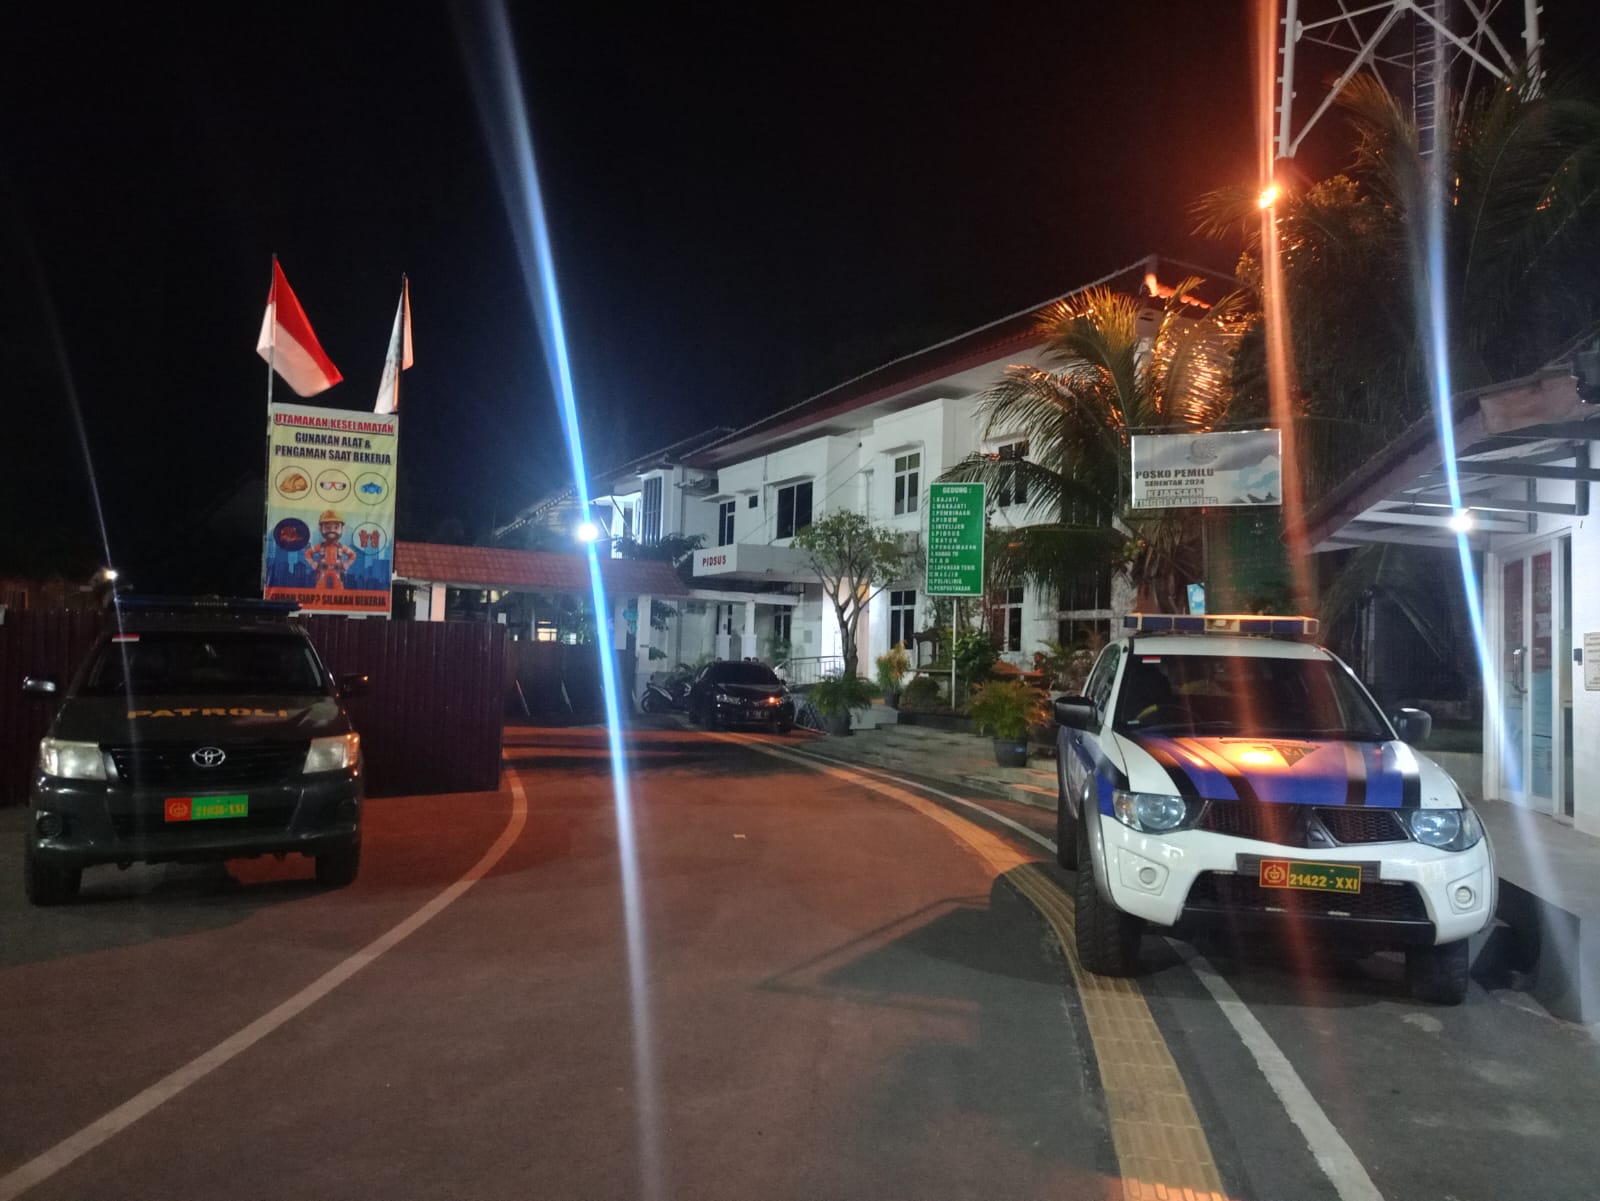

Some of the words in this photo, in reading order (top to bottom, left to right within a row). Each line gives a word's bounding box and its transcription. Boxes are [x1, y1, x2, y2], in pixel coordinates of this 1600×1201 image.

[274, 412, 328, 426] UTAMAKAN
[329, 416, 394, 433] KESELAMATAN
[295, 431, 340, 446] GUNAKAN
[341, 436, 363, 449] ALAT
[364, 439, 371, 449] &
[274, 444, 327, 460] PENGAMAN
[328, 448, 352, 462] SAAT
[353, 451, 391, 465] BEKERJA
[1135, 469, 1172, 479] POSKO
[1174, 468, 1214, 478] PEMILU
[1184, 478, 1205, 486] 2024
[702, 555, 727, 567] PIDSUS
[127, 708, 288, 719] PATROLI
